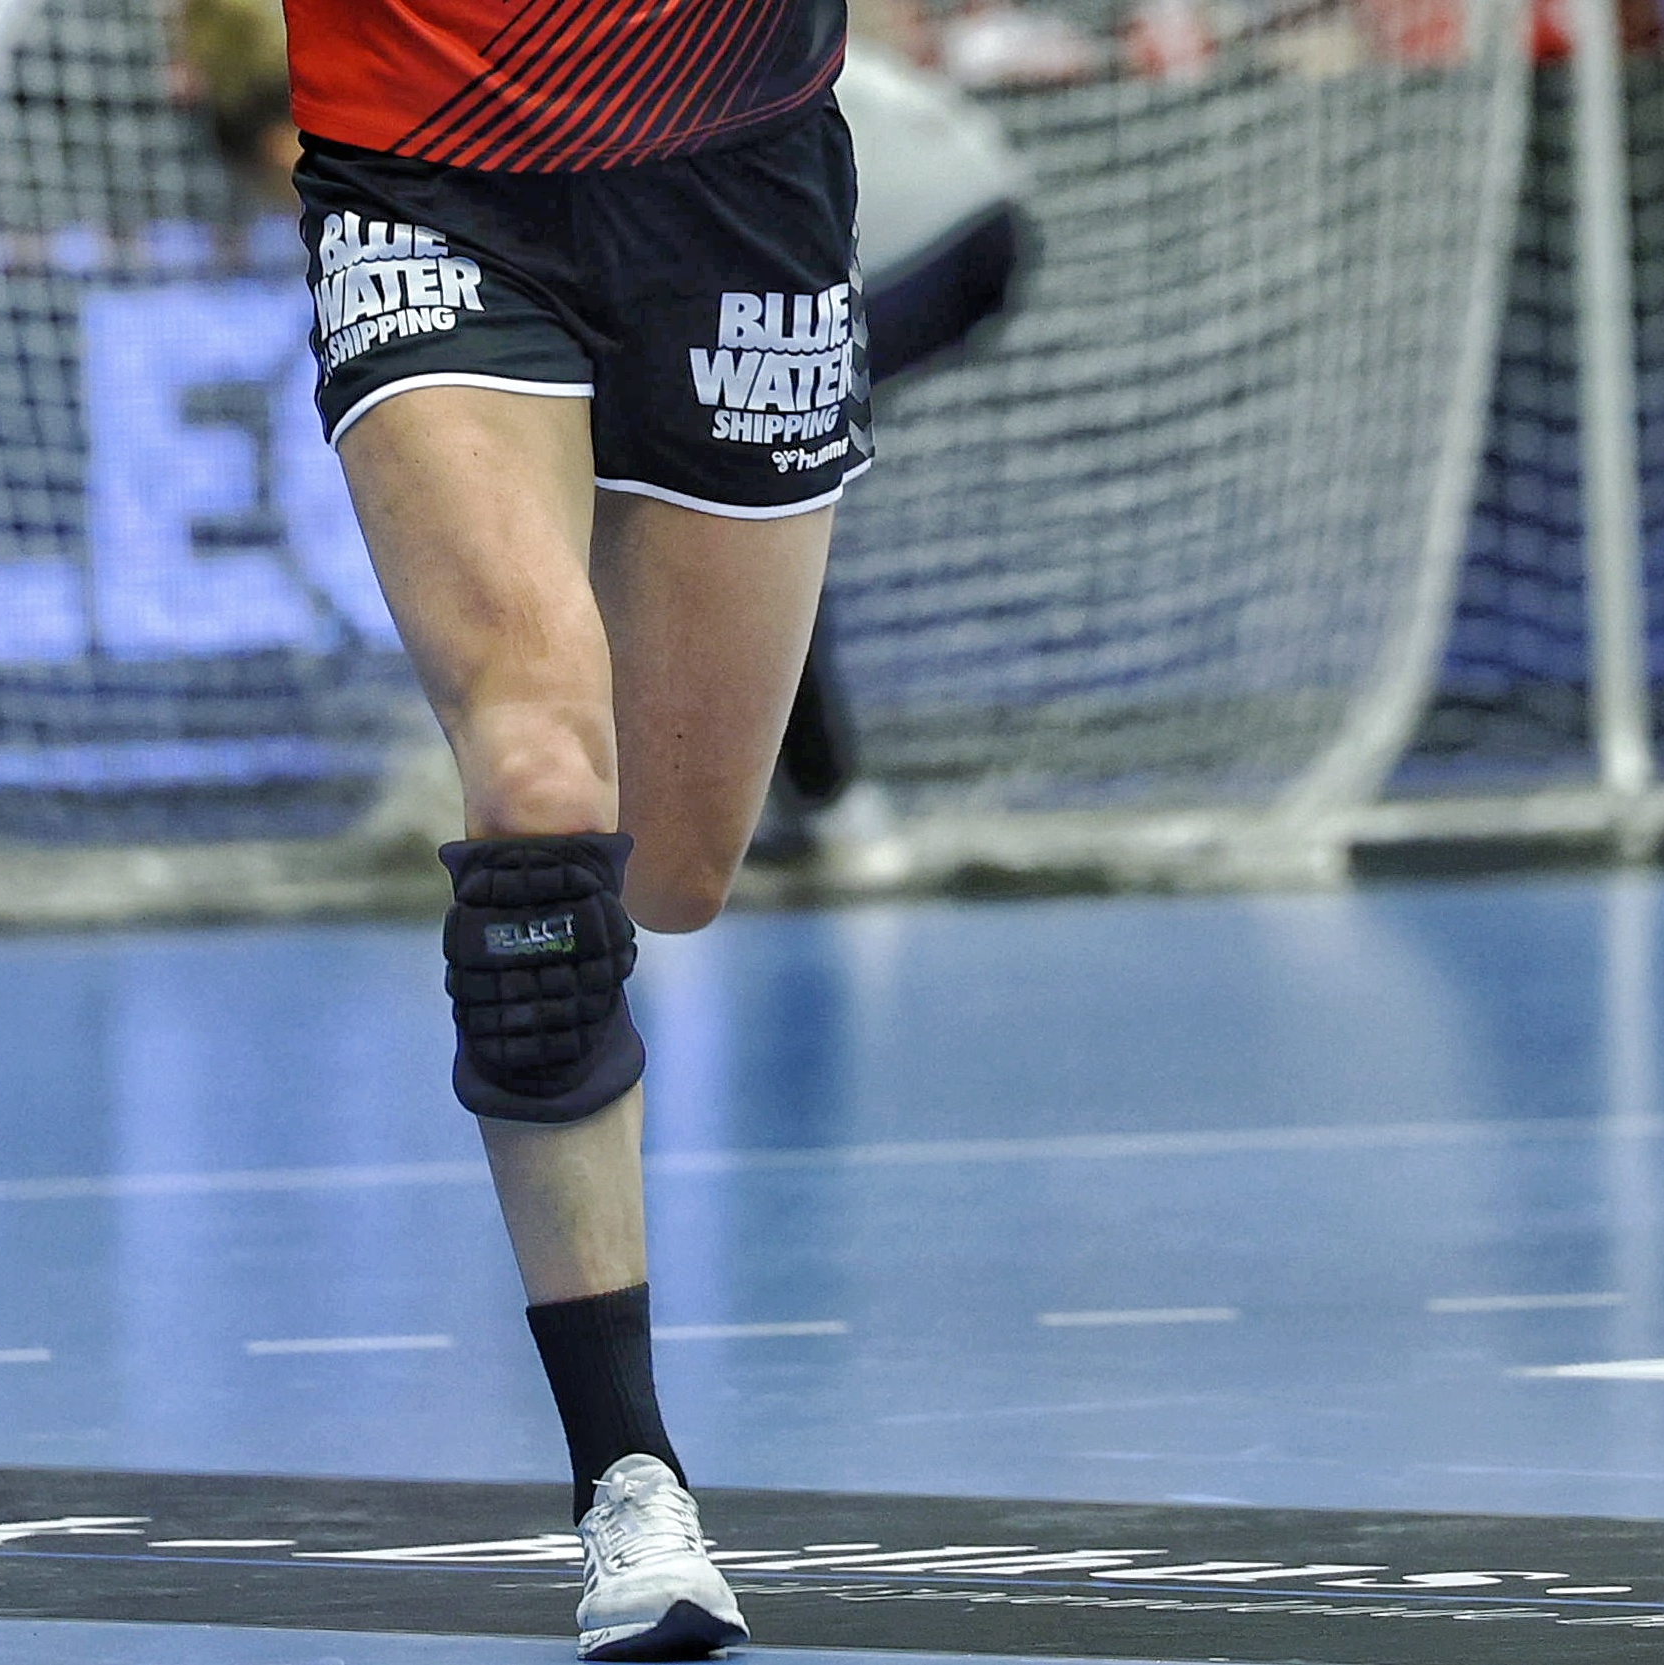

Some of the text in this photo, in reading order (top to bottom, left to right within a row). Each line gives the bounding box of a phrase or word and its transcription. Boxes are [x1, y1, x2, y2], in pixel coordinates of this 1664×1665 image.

[319, 210, 450, 277] BLUE
[314, 255, 486, 342] WATER
[717, 282, 850, 353] BLUE
[328, 306, 456, 368] SHIPPING
[688, 337, 854, 413] WATER
[711, 404, 841, 444] SHIPPING
